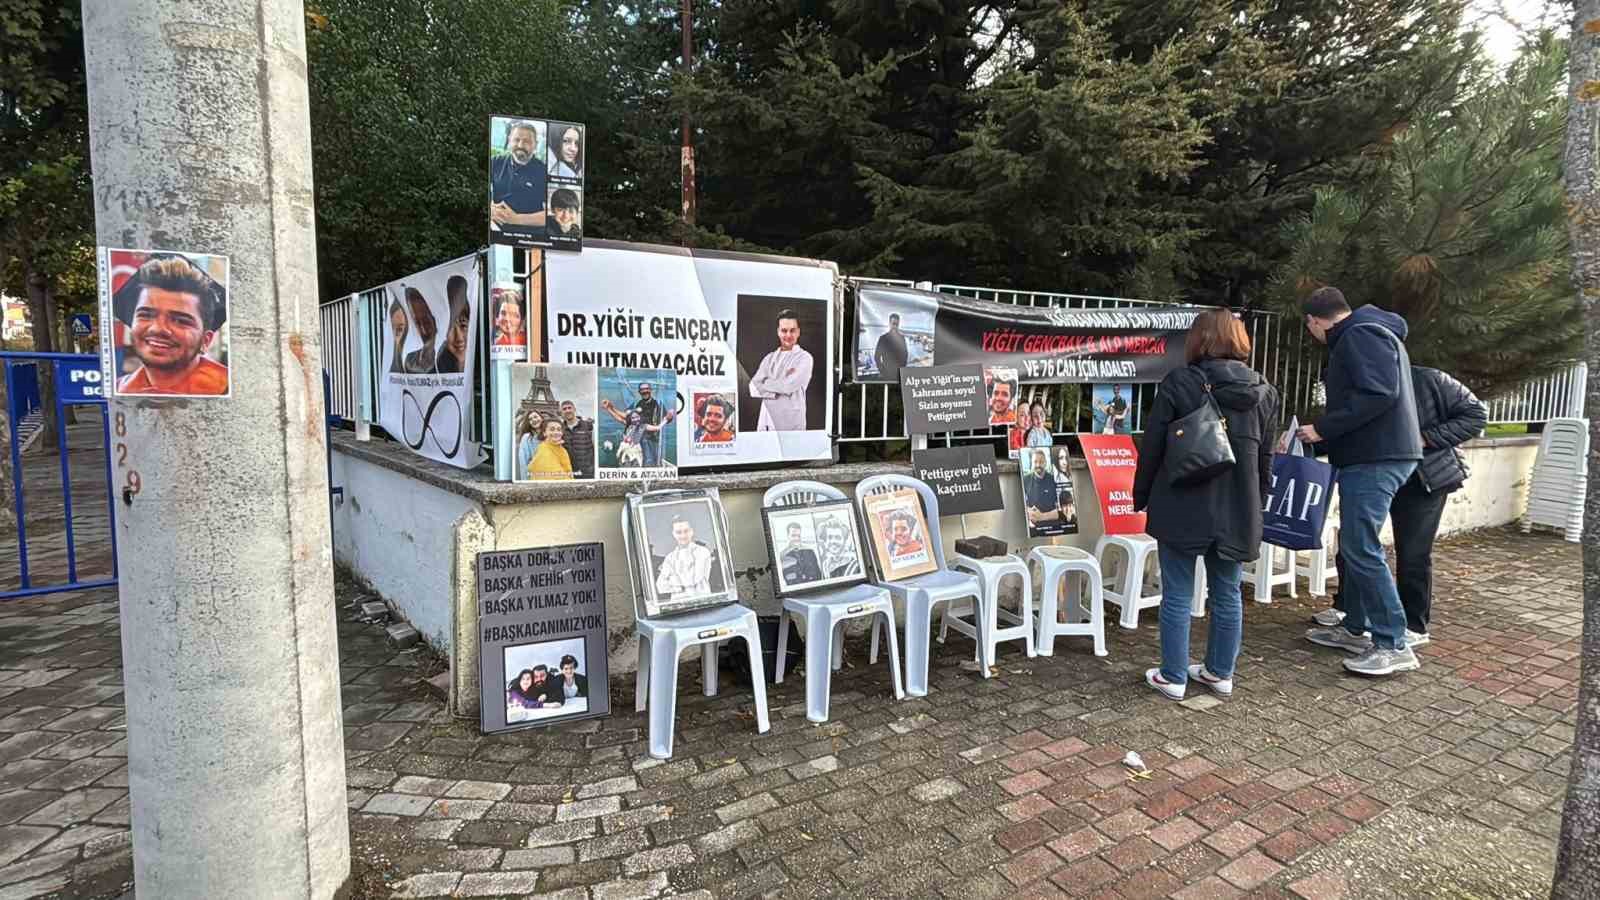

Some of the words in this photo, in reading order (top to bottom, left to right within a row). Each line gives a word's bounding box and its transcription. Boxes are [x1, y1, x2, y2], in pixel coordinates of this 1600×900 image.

[557, 307, 645, 338] DR.YİĞİT
[649, 316, 732, 347] GENÇBAY
[982, 328, 1023, 353] YİĞİT
[1023, 334, 1086, 355] GENÇBAY
[1099, 336, 1122, 353] ALP
[1124, 336, 1168, 354] MERCAN
[1023, 360, 1040, 377] VE
[1041, 360, 1055, 377] 76
[1056, 359, 1077, 377] CAN
[1077, 356, 1099, 381] İÇİN
[1100, 360, 1137, 377] ADALET!
[905, 376, 920, 388] Alp
[962, 376, 980, 385] soyu
[911, 388, 953, 398] kahraman
[954, 385, 977, 398] soyu!
[918, 401, 939, 410] Sizin
[940, 400, 973, 411] soyunuz
[927, 409, 967, 423] Pettigrew!
[600, 469, 628, 480] DERİN
[631, 470, 638, 479] &
[920, 468, 969, 481] Pettigrew
[971, 463, 993, 479] gibi
[484, 554, 523, 571] BAŞKA
[527, 551, 565, 567] DORUK
[484, 575, 524, 594] BAŞKA
[529, 571, 564, 588] NEHİR
[571, 568, 597, 584] YOK!
[485, 595, 525, 615] BAŞKA
[526, 591, 569, 610] YILMAZ
[571, 588, 597, 605] YOK!
[484, 614, 603, 643] #BAŞKACANIMIZYOK
